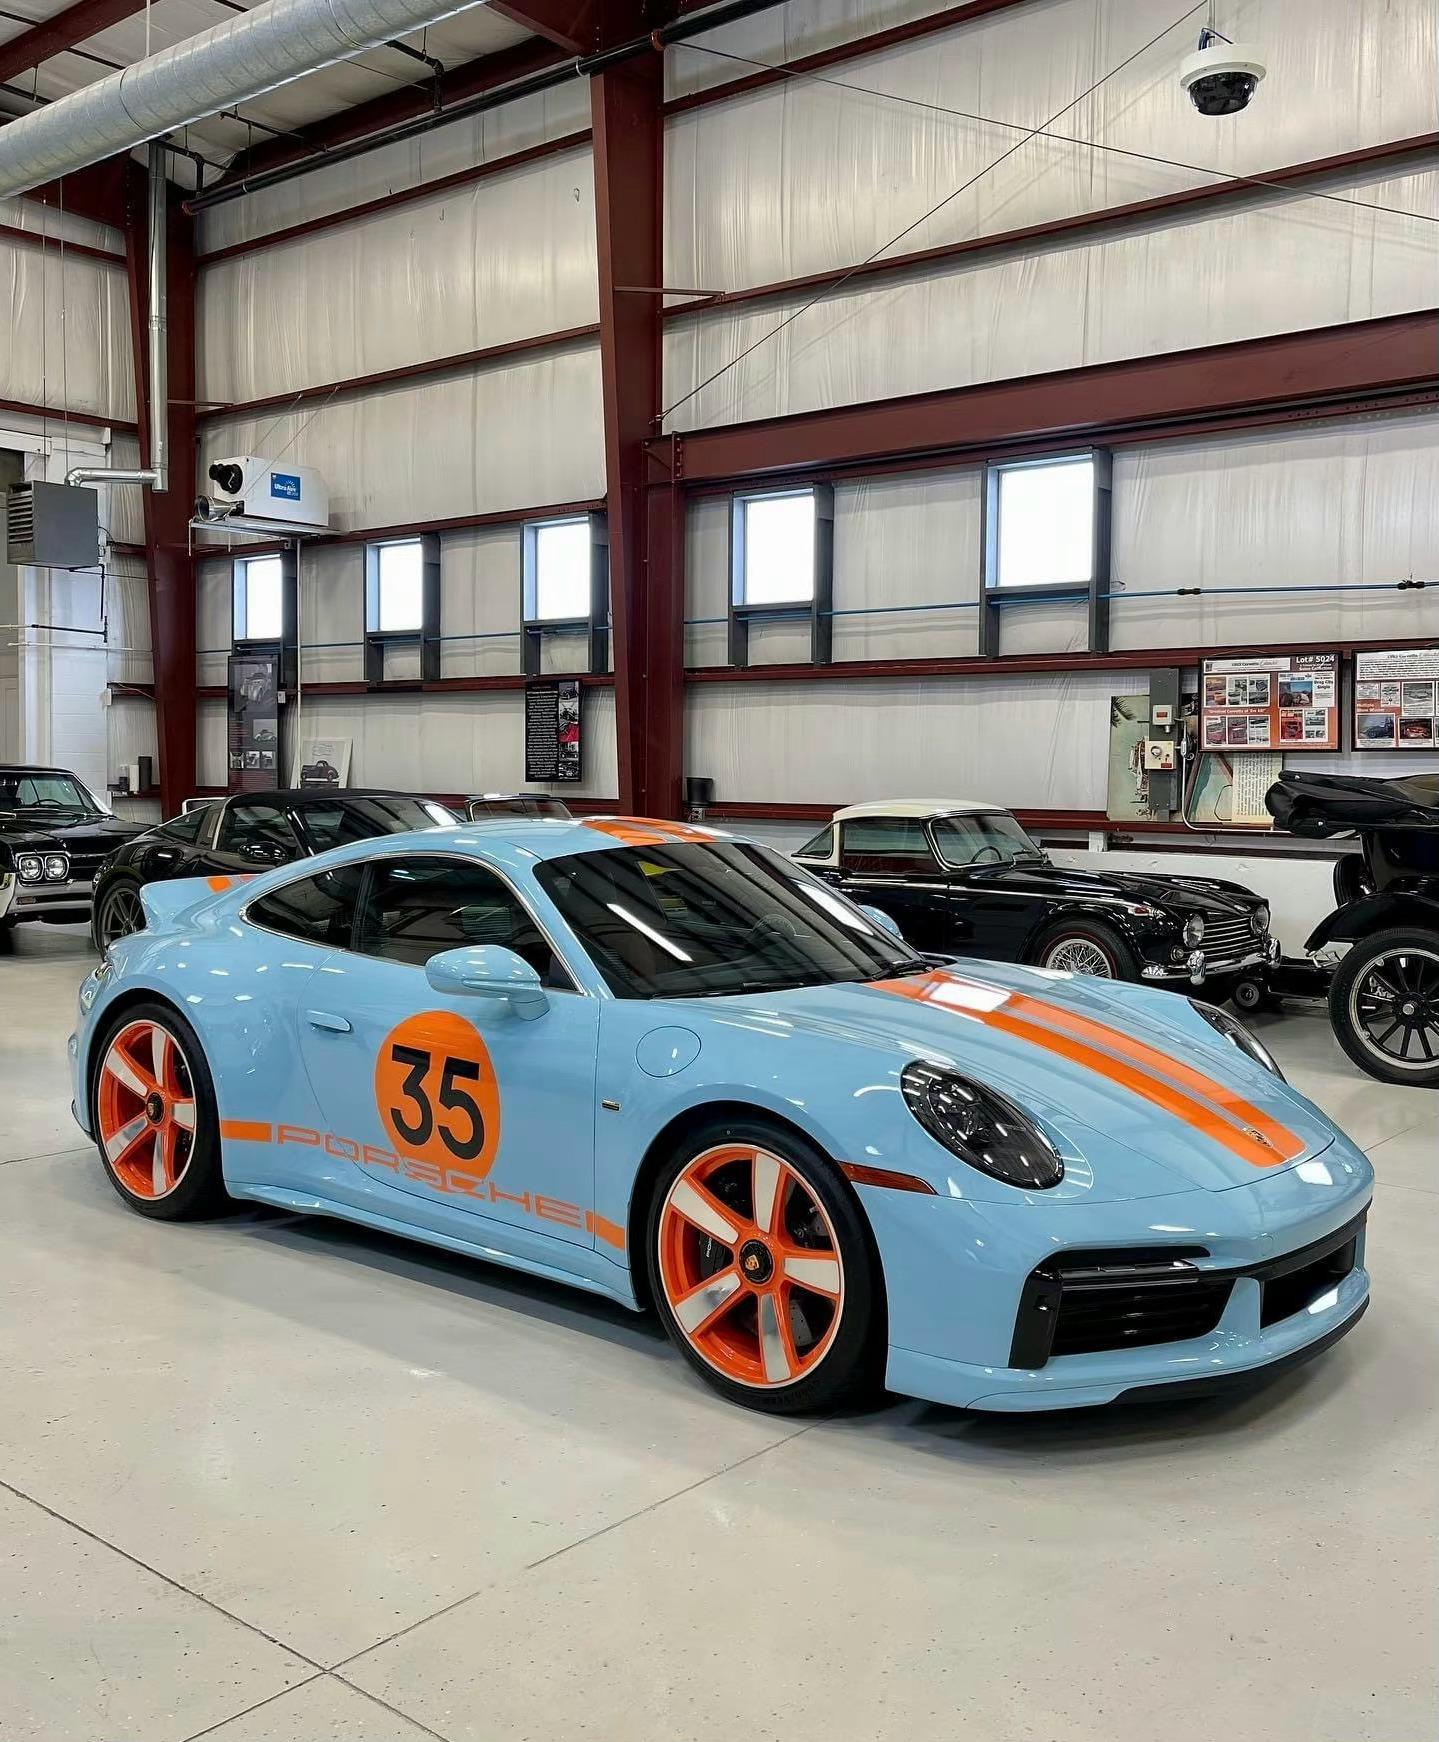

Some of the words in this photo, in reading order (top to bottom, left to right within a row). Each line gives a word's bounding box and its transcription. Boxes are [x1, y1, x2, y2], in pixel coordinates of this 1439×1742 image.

[1296, 656, 1314, 664] Lot#
[1315, 654, 1335, 663] 5024
[391, 1043, 485, 1160] 35
[277, 1124, 582, 1230] PORSCHE
